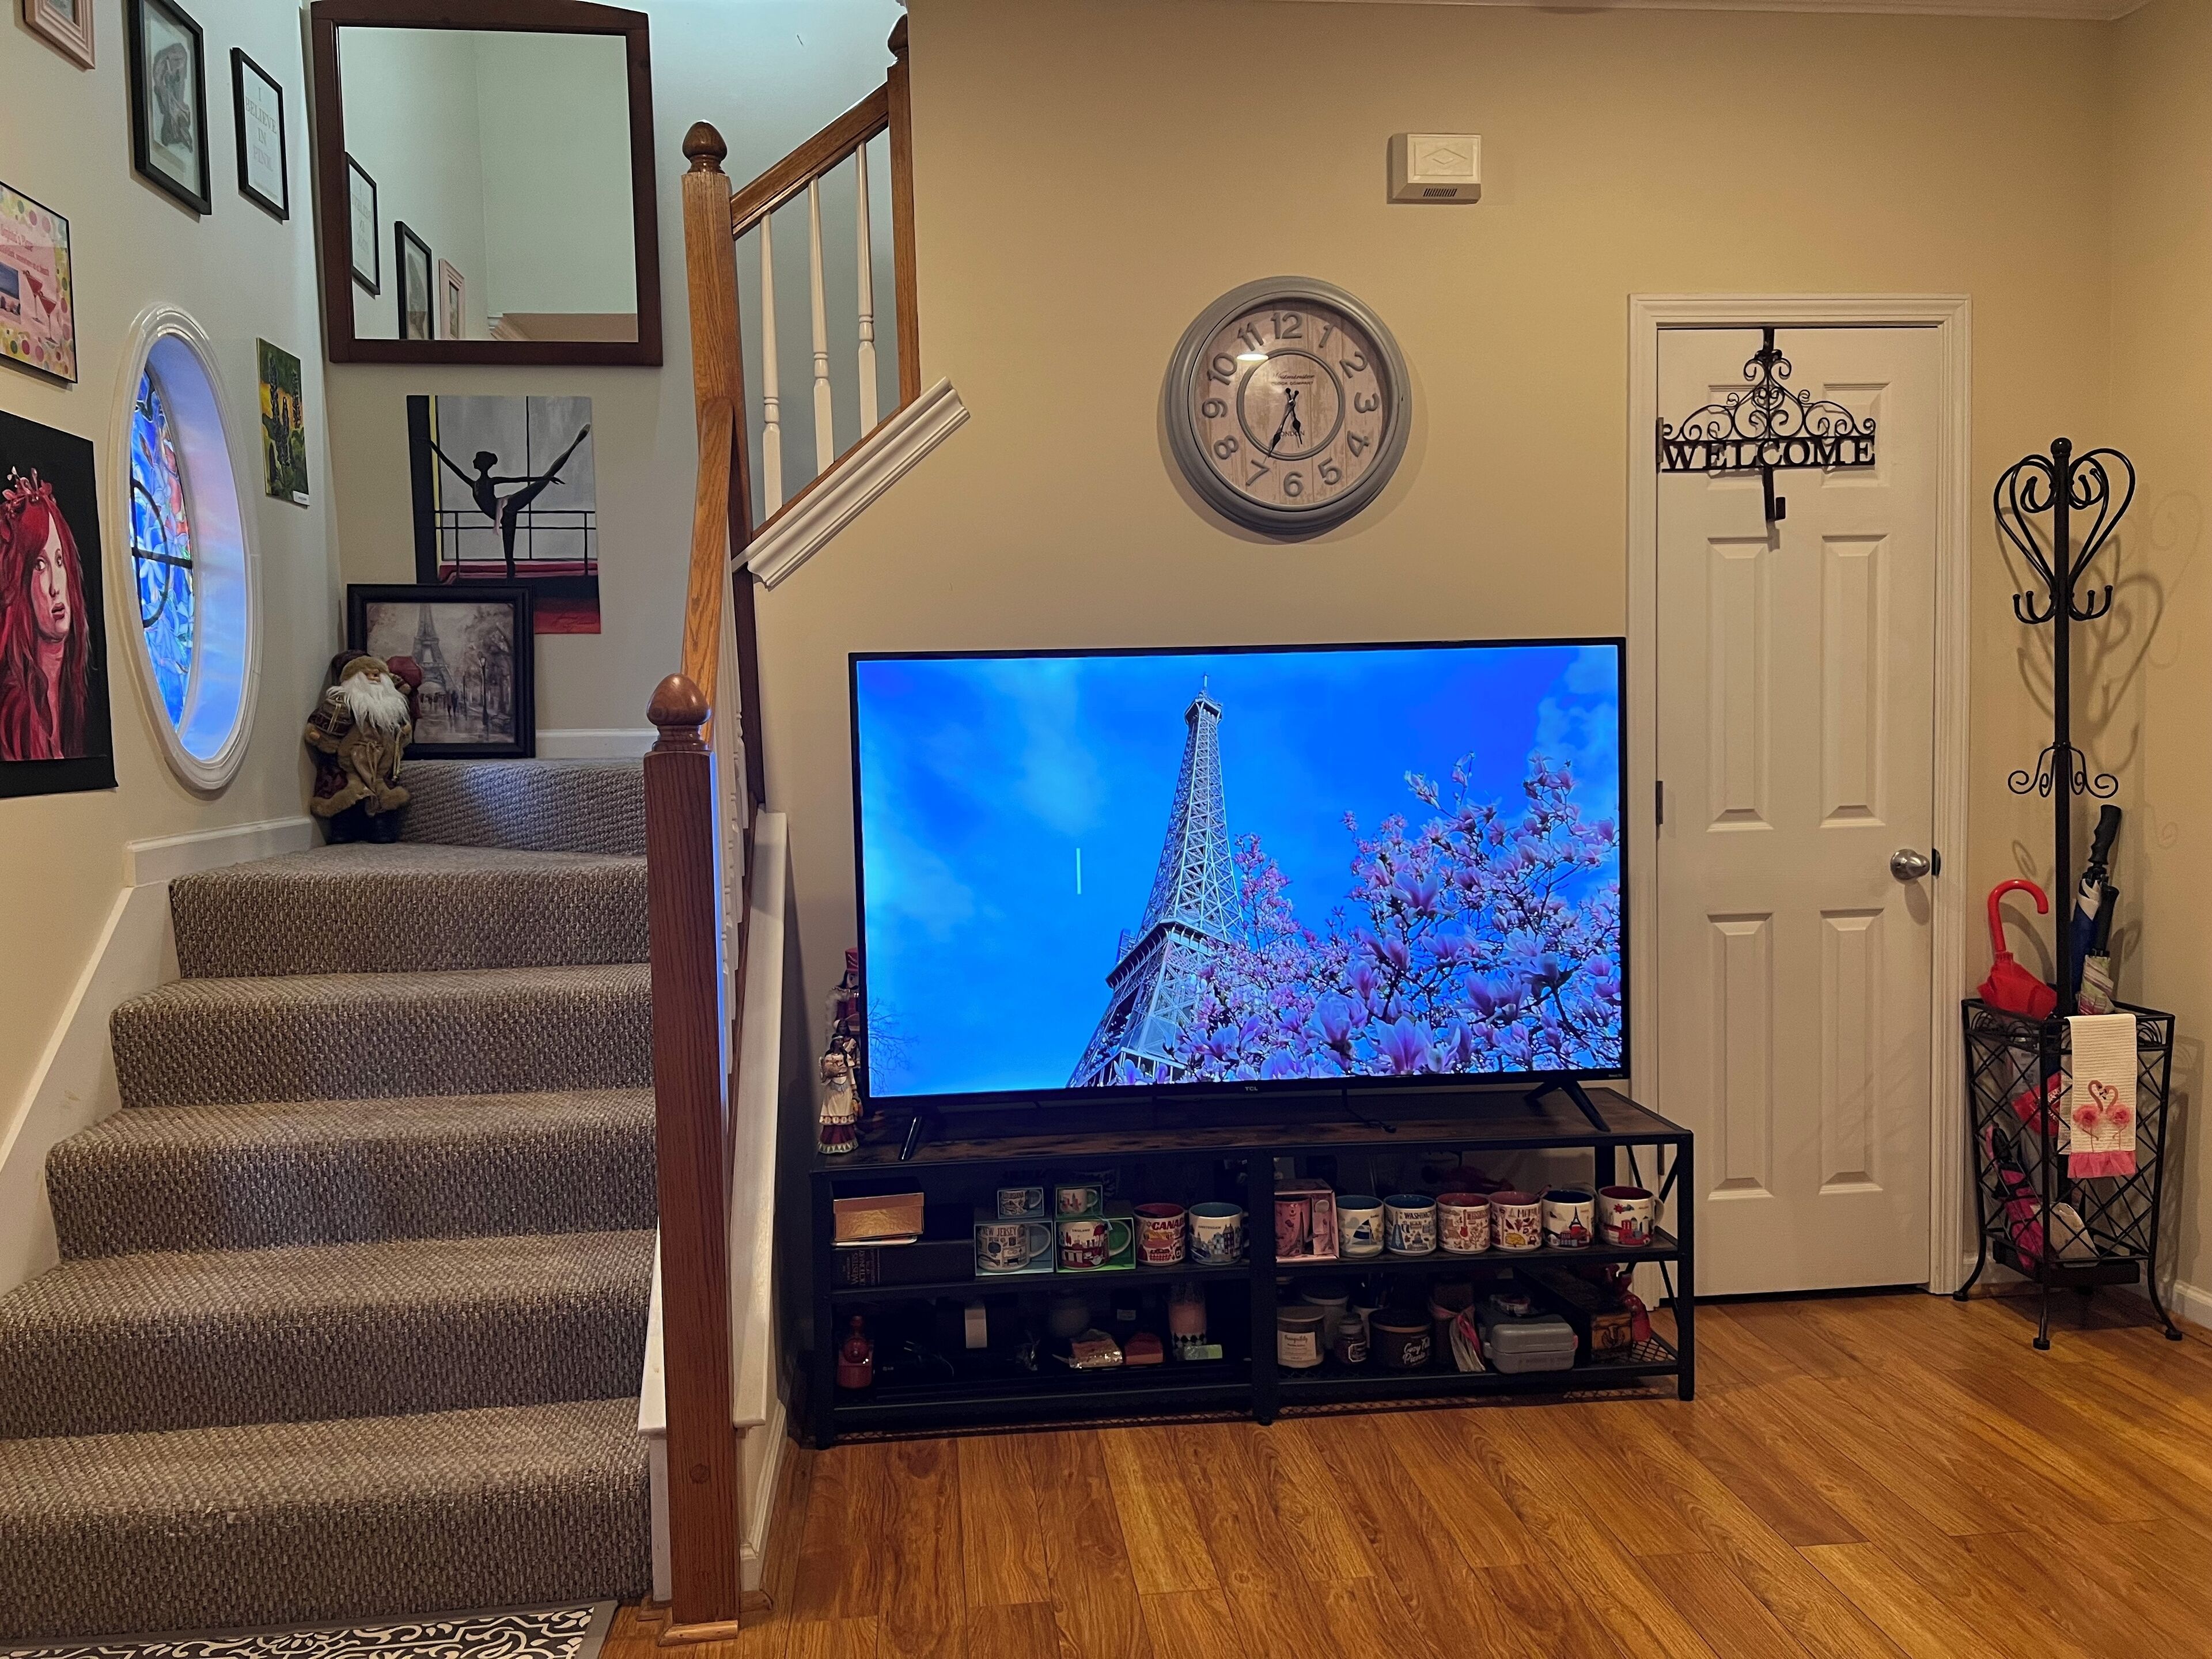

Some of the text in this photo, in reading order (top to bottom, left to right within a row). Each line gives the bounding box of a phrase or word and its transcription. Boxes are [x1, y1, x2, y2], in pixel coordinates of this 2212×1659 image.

[245, 96, 276, 134] BELIEVE
[257, 127, 267, 145] IN
[1237, 323, 1264, 351] 11
[1271, 312, 1302, 339] 12
[1318, 324, 1335, 348] 1
[1207, 353, 1238, 385] 10
[1339, 351, 1368, 378] 2
[1202, 397, 1228, 418] 9
[1354, 392, 1379, 414] 3
[1213, 435, 1239, 460] 8
[1347, 430, 1370, 457] 4
[1662, 436, 1875, 470] WELCOME
[1245, 459, 1270, 486] 7
[1283, 471, 1303, 497] 6
[1317, 457, 1342, 485] 5
[982, 1226, 1017, 1237] NEW JERSEY
